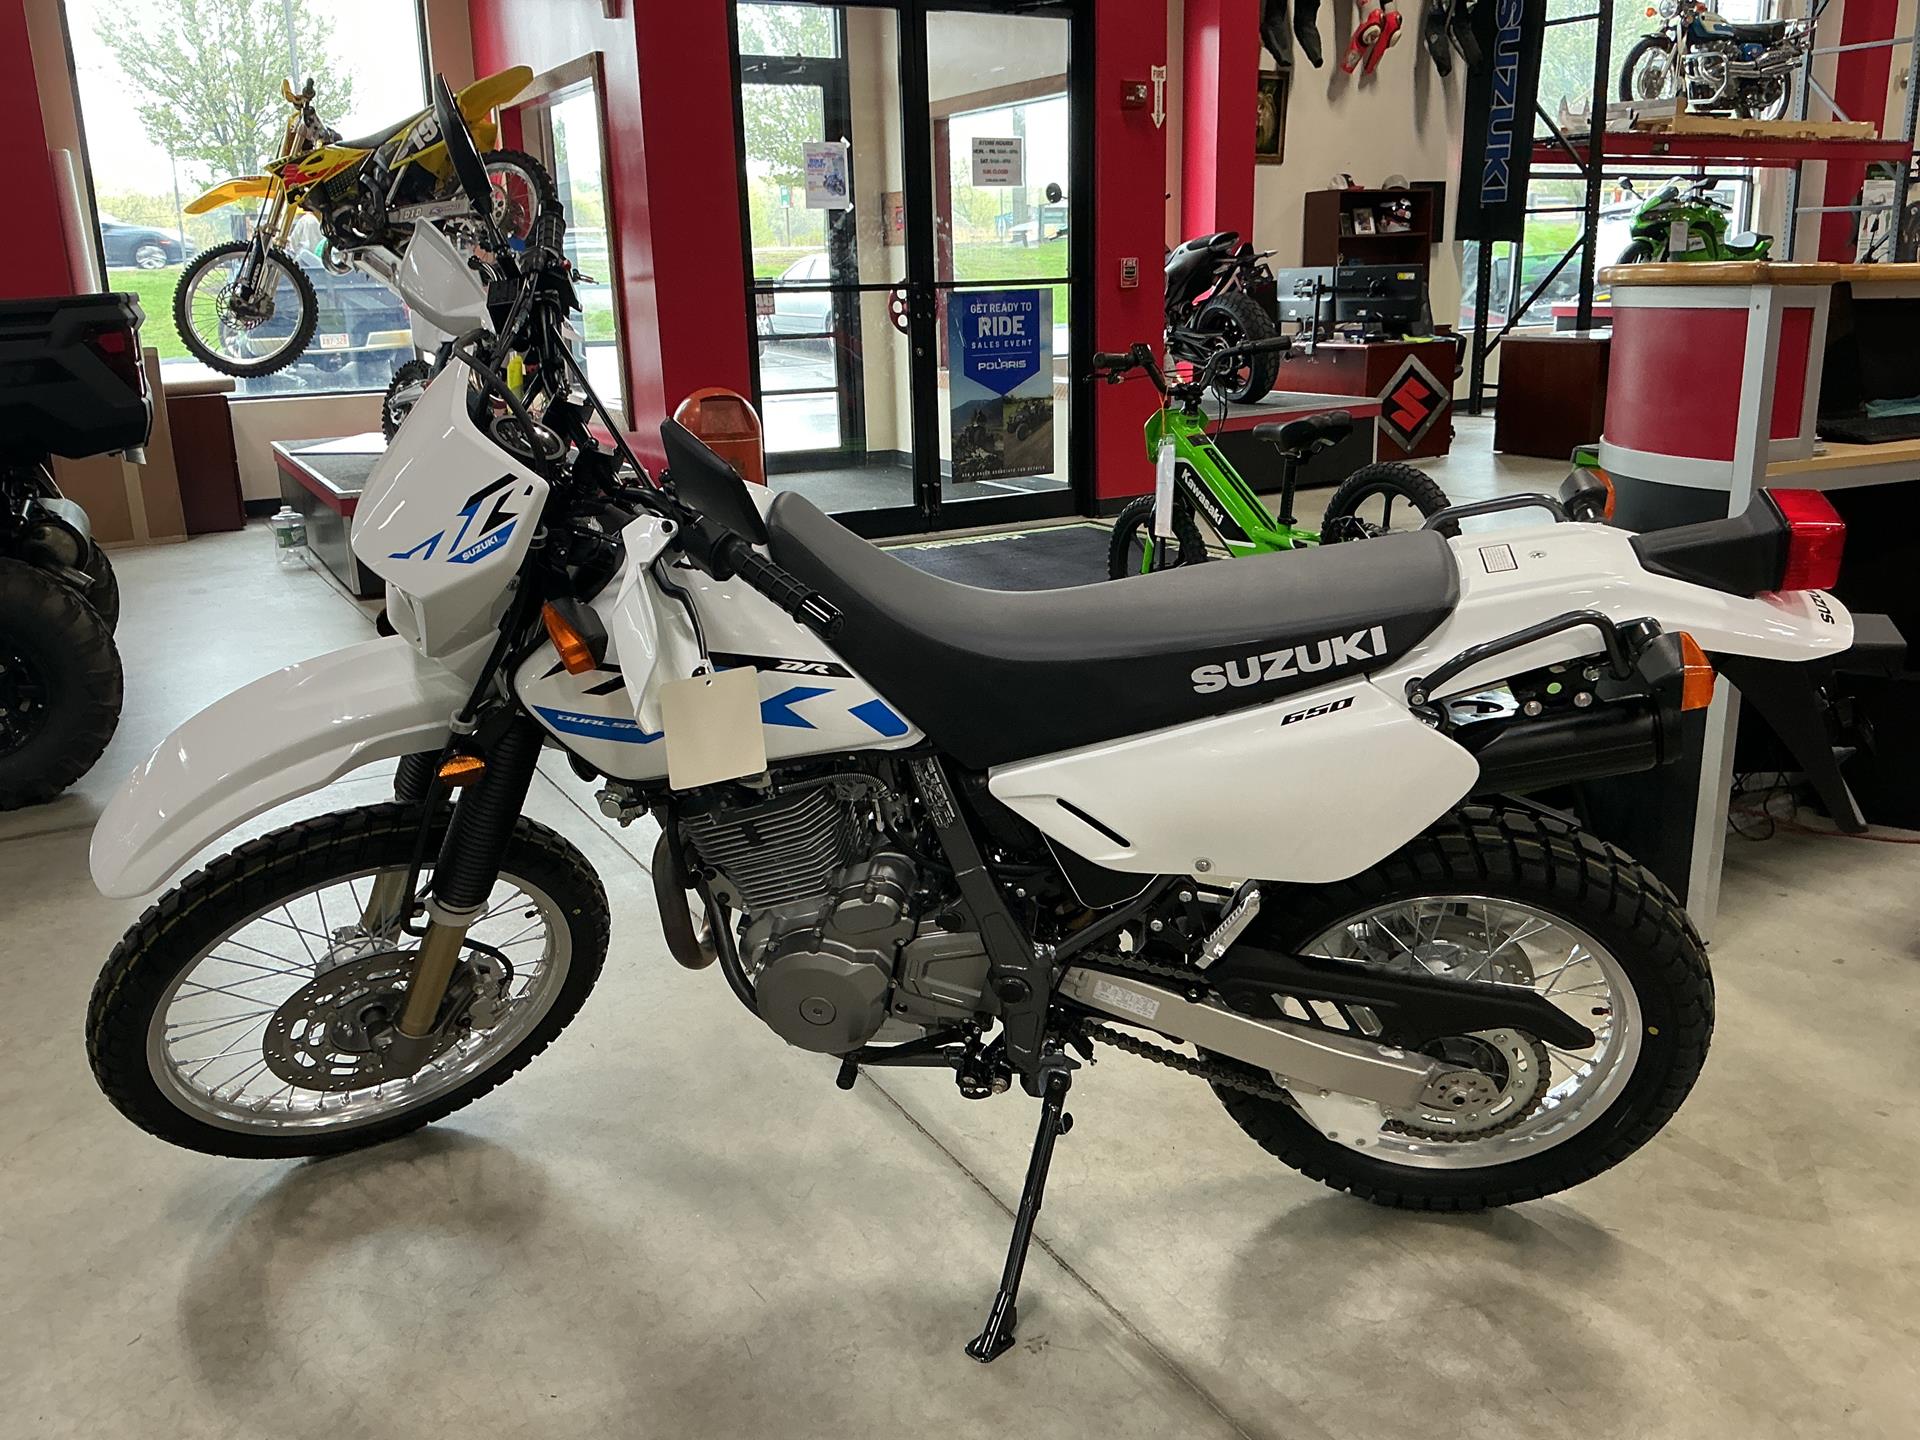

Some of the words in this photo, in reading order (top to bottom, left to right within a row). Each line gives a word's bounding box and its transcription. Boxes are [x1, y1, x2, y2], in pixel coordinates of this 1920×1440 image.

[1480, 0, 1525, 202] SUZUKI
[970, 303, 987, 314] GET
[989, 302, 1019, 313] READY
[1020, 302, 1032, 311] TO
[978, 315, 1025, 338] RIDE
[971, 341, 1000, 350] SALES
[1004, 339, 1032, 348] EVENT
[977, 359, 1027, 371] POLARIS
[1181, 468, 1224, 526] Kawasaki
[462, 535, 499, 561] SUZUKI
[775, 660, 830, 675] DR
[1191, 625, 1387, 694] SUZUKI
[557, 714, 610, 728] DUAL
[1280, 696, 1356, 726] 650
